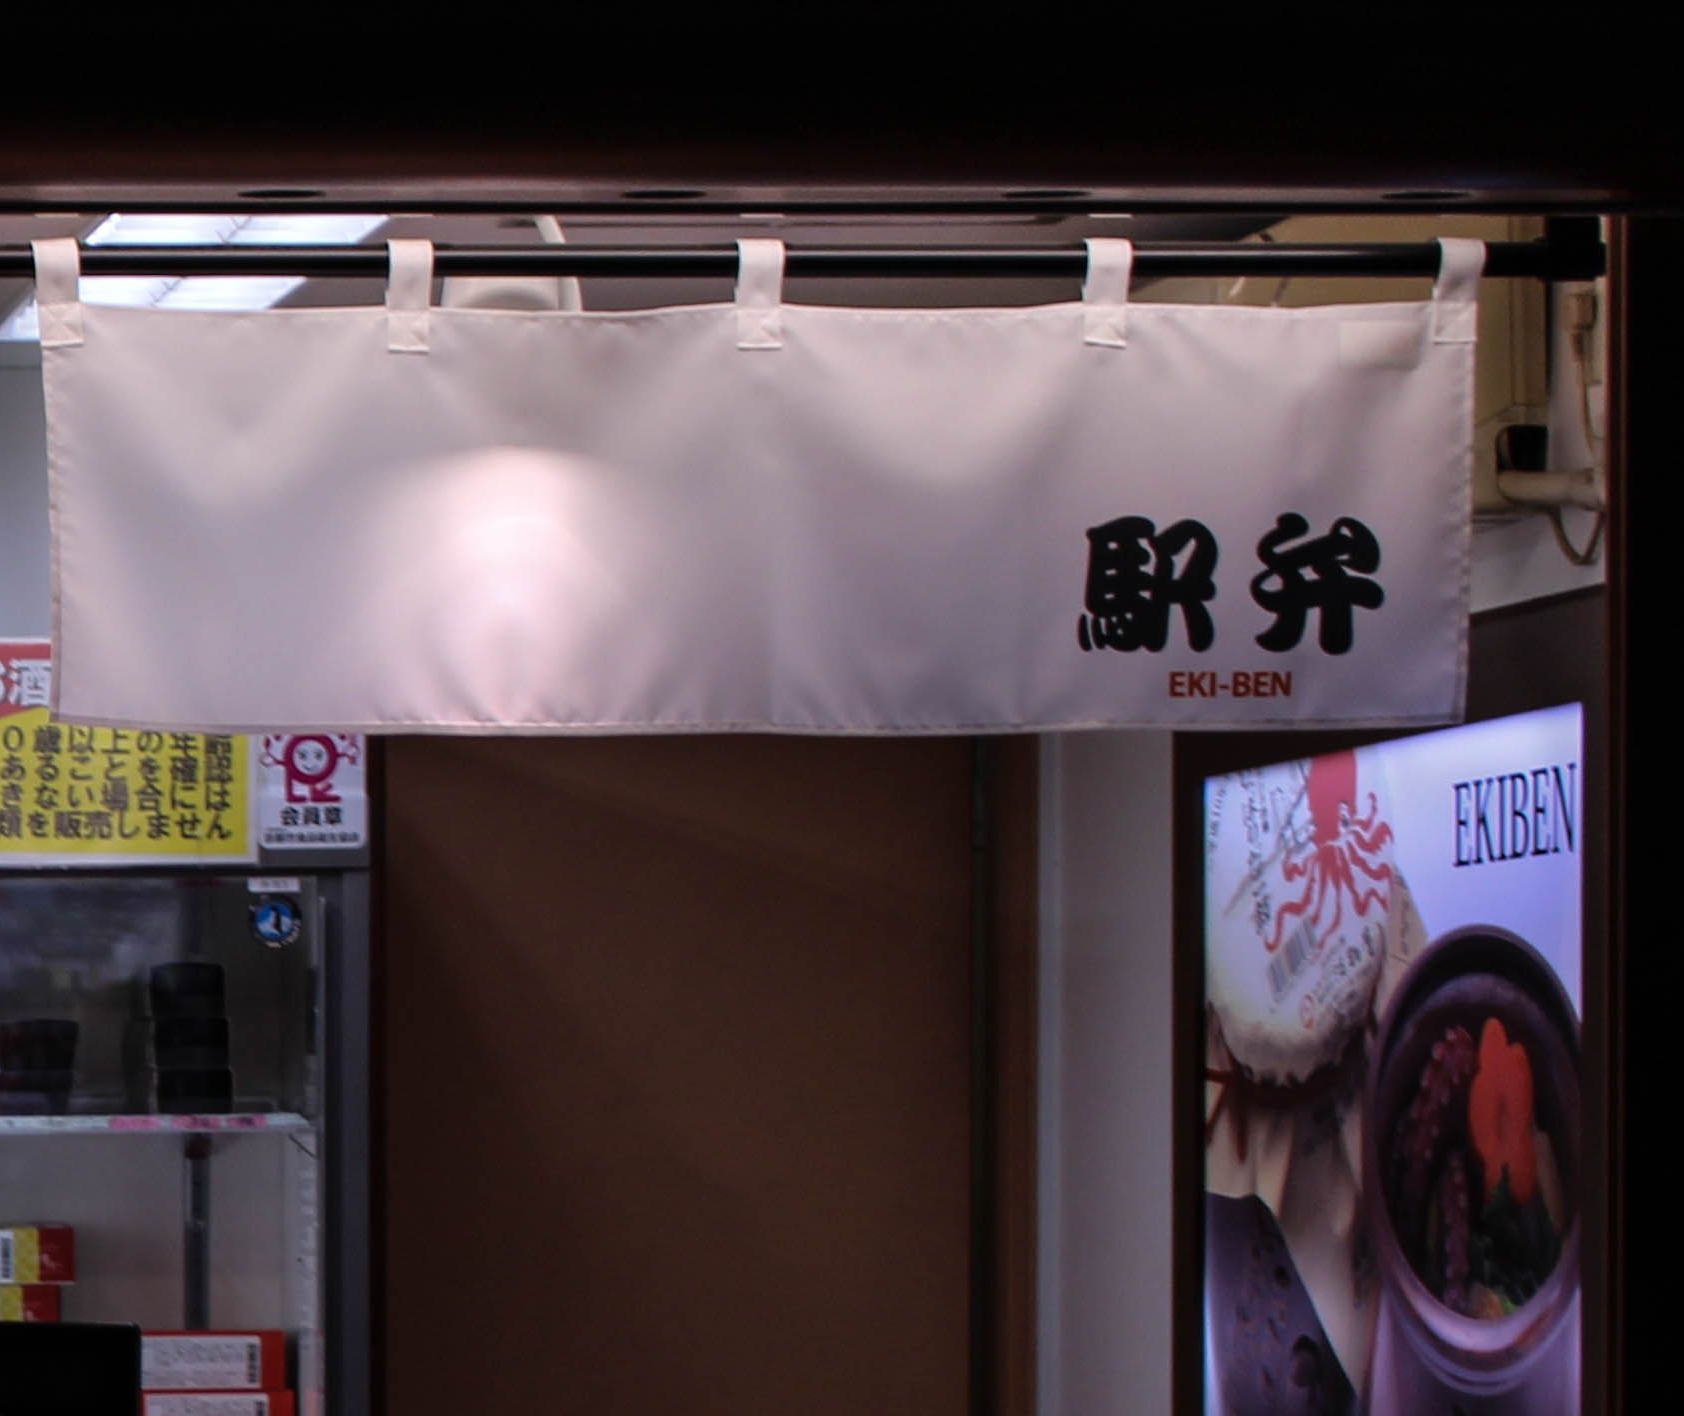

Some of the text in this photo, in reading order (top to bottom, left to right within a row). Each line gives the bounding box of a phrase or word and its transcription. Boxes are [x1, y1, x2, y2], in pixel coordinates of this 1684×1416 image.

[1077, 512, 1384, 655] 駅弁
[1169, 671, 1292, 697] EKI-BEN
[1453, 762, 1576, 868] EKIBEN
